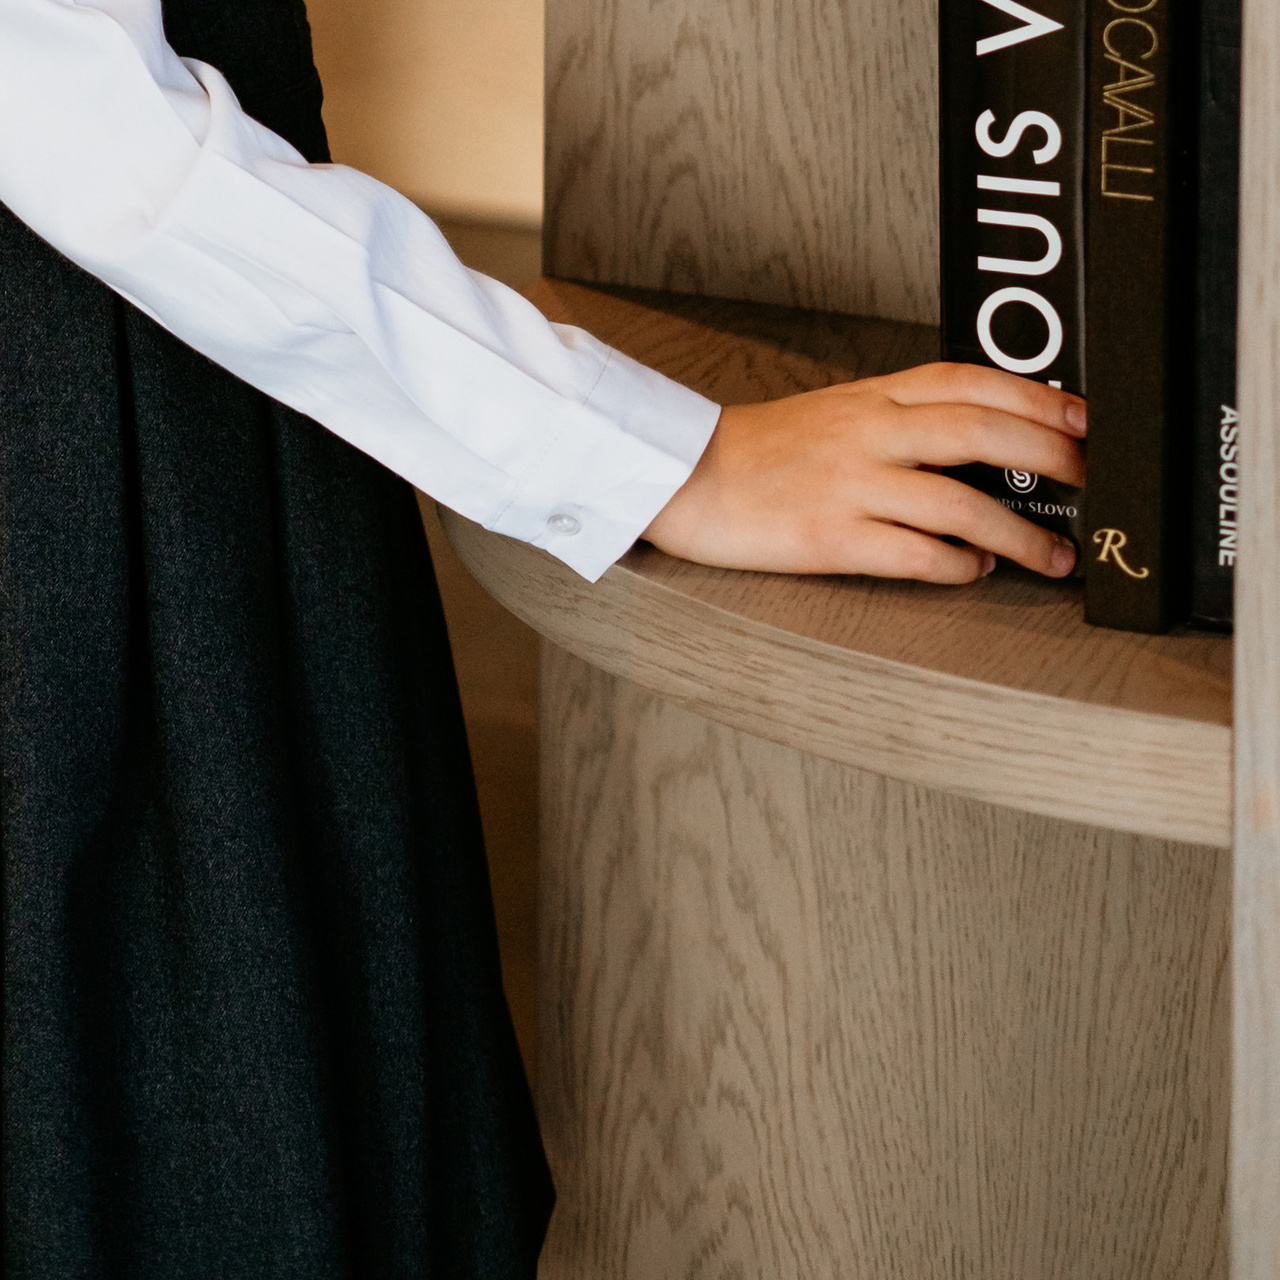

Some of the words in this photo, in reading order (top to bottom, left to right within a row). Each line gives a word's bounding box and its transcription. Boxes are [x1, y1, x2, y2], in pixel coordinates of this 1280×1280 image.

[1101, 17, 1158, 201] CAVALLI
[975, 108, 1065, 390] OUIS
[1219, 404, 1238, 566] ASSOULINE
